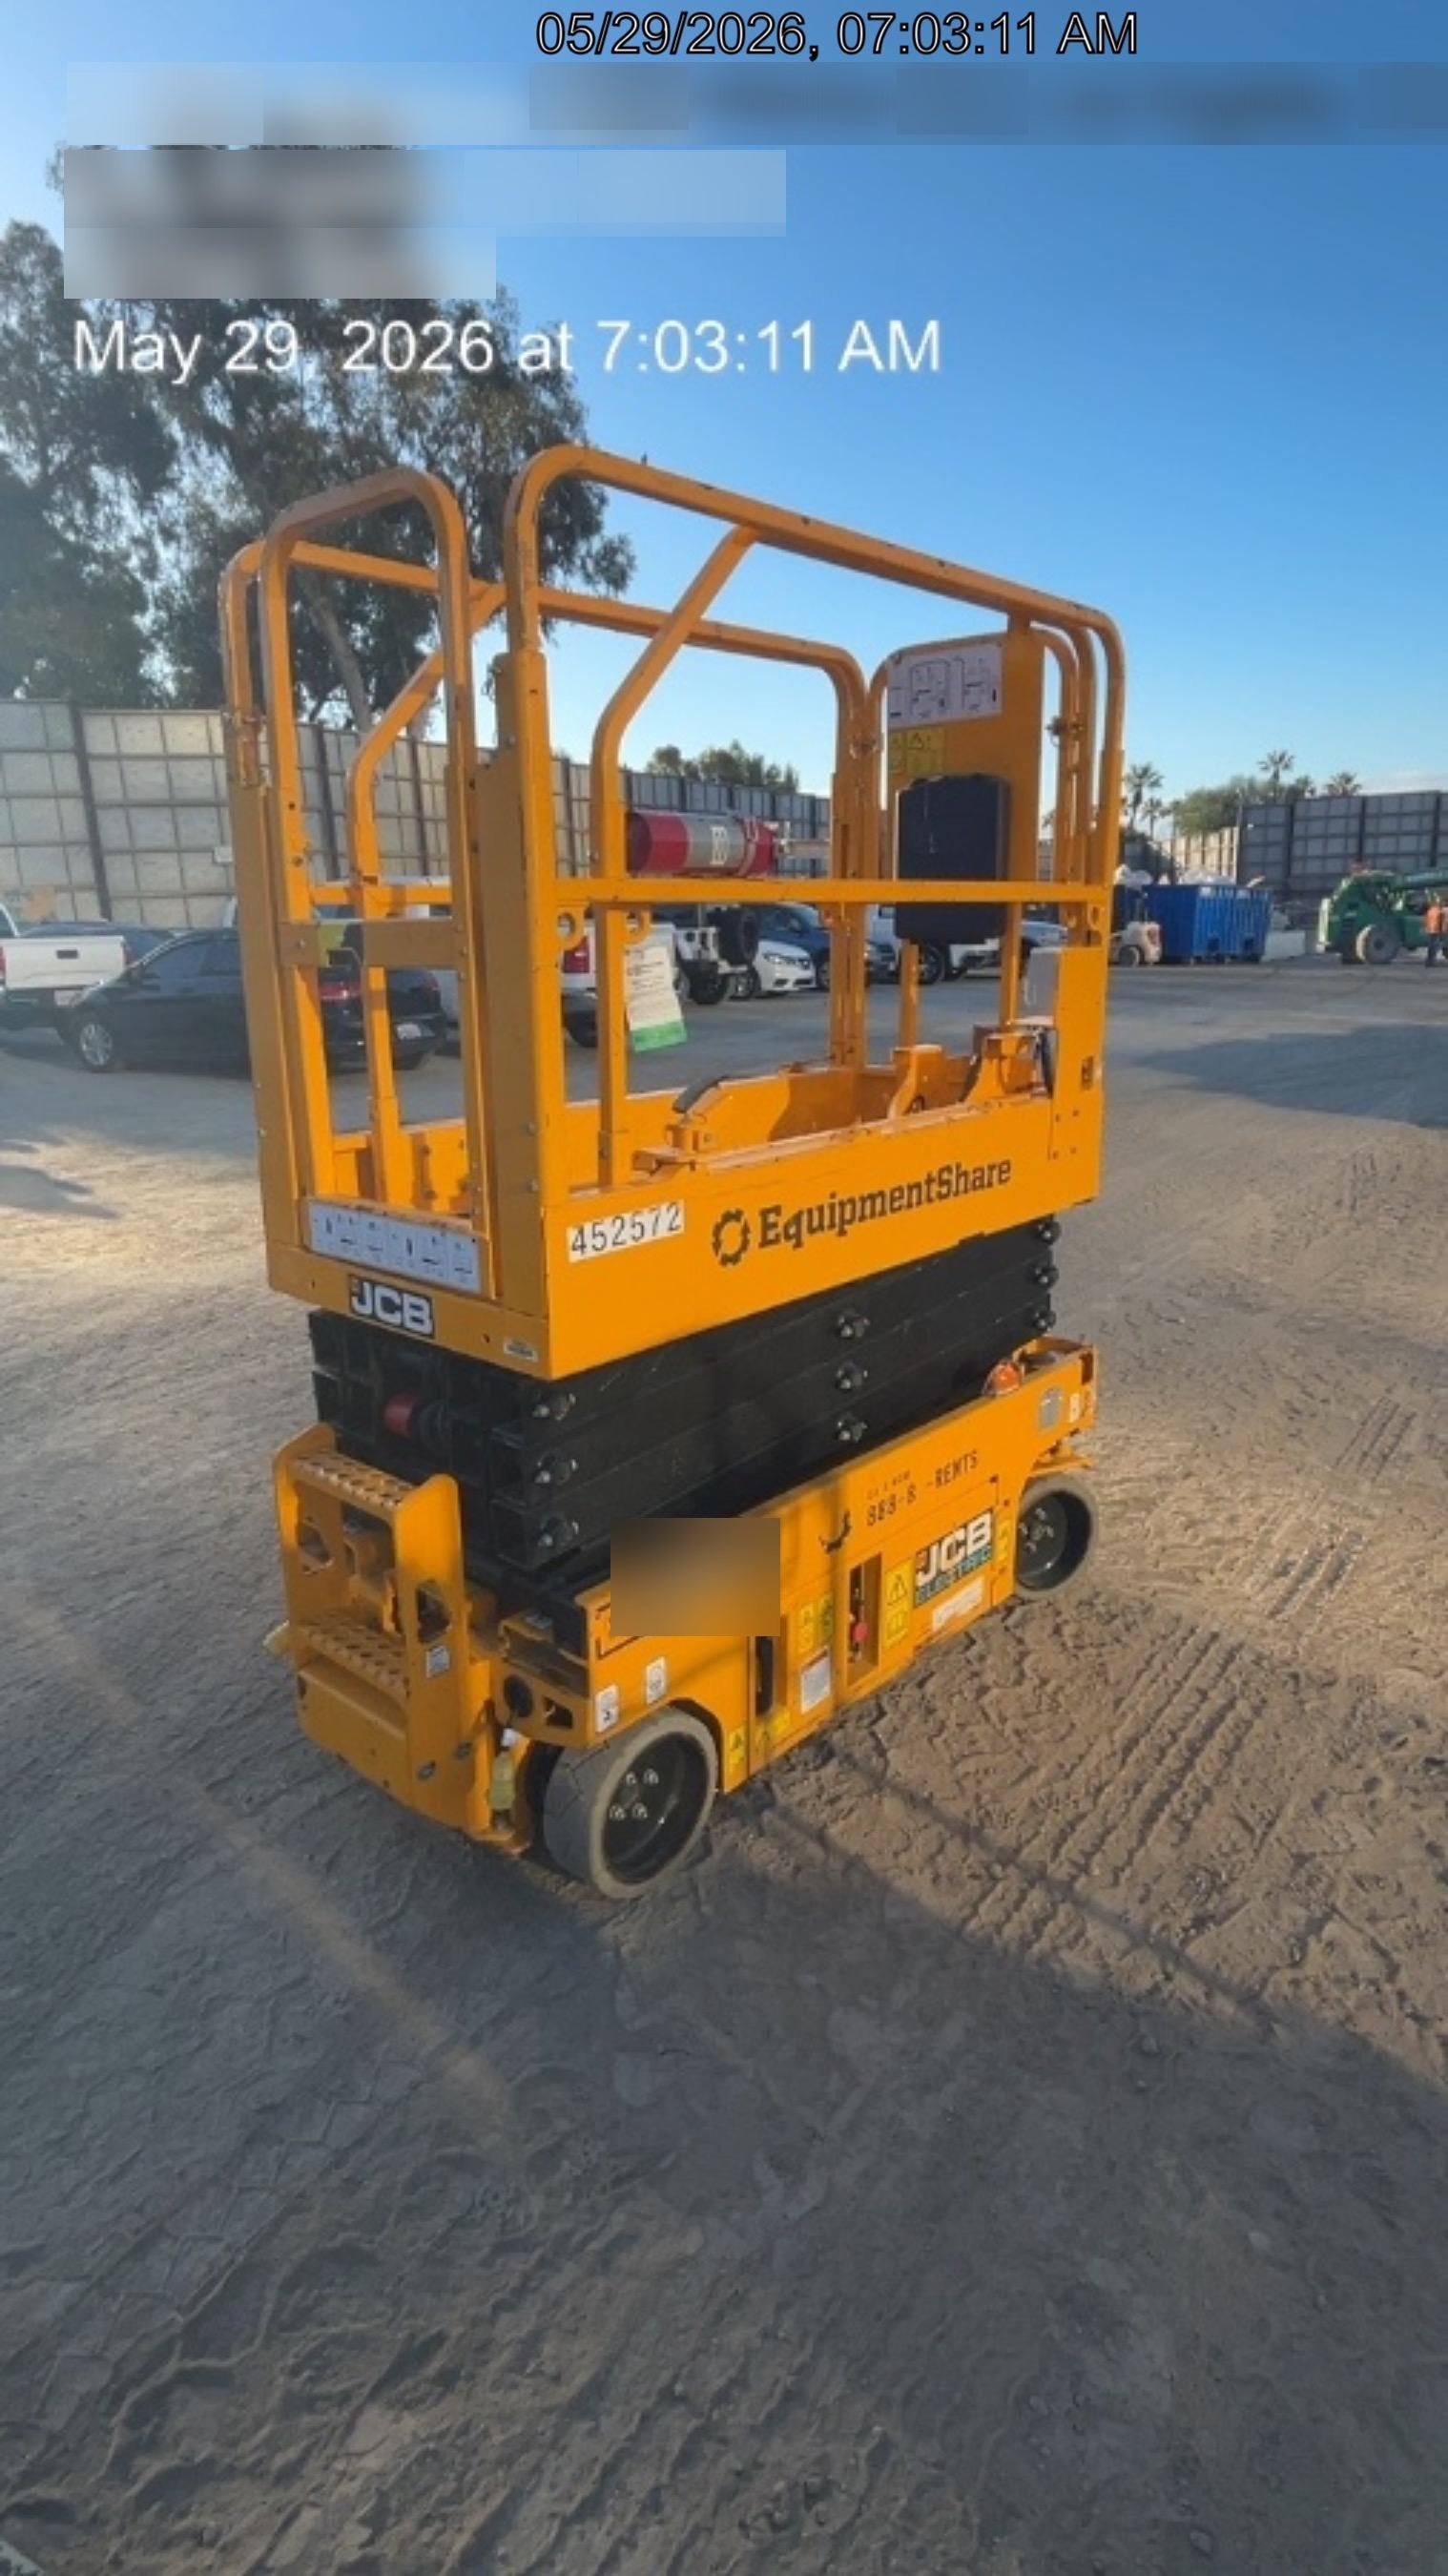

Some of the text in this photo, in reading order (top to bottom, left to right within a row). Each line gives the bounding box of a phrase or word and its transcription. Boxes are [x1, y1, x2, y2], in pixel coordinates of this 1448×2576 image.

[570, 1201, 682, 1255] 452572
[757, 1158, 1011, 1250] EquipmentShare
[351, 1279, 434, 1336] JCB
[916, 1512, 991, 1588] JCB
